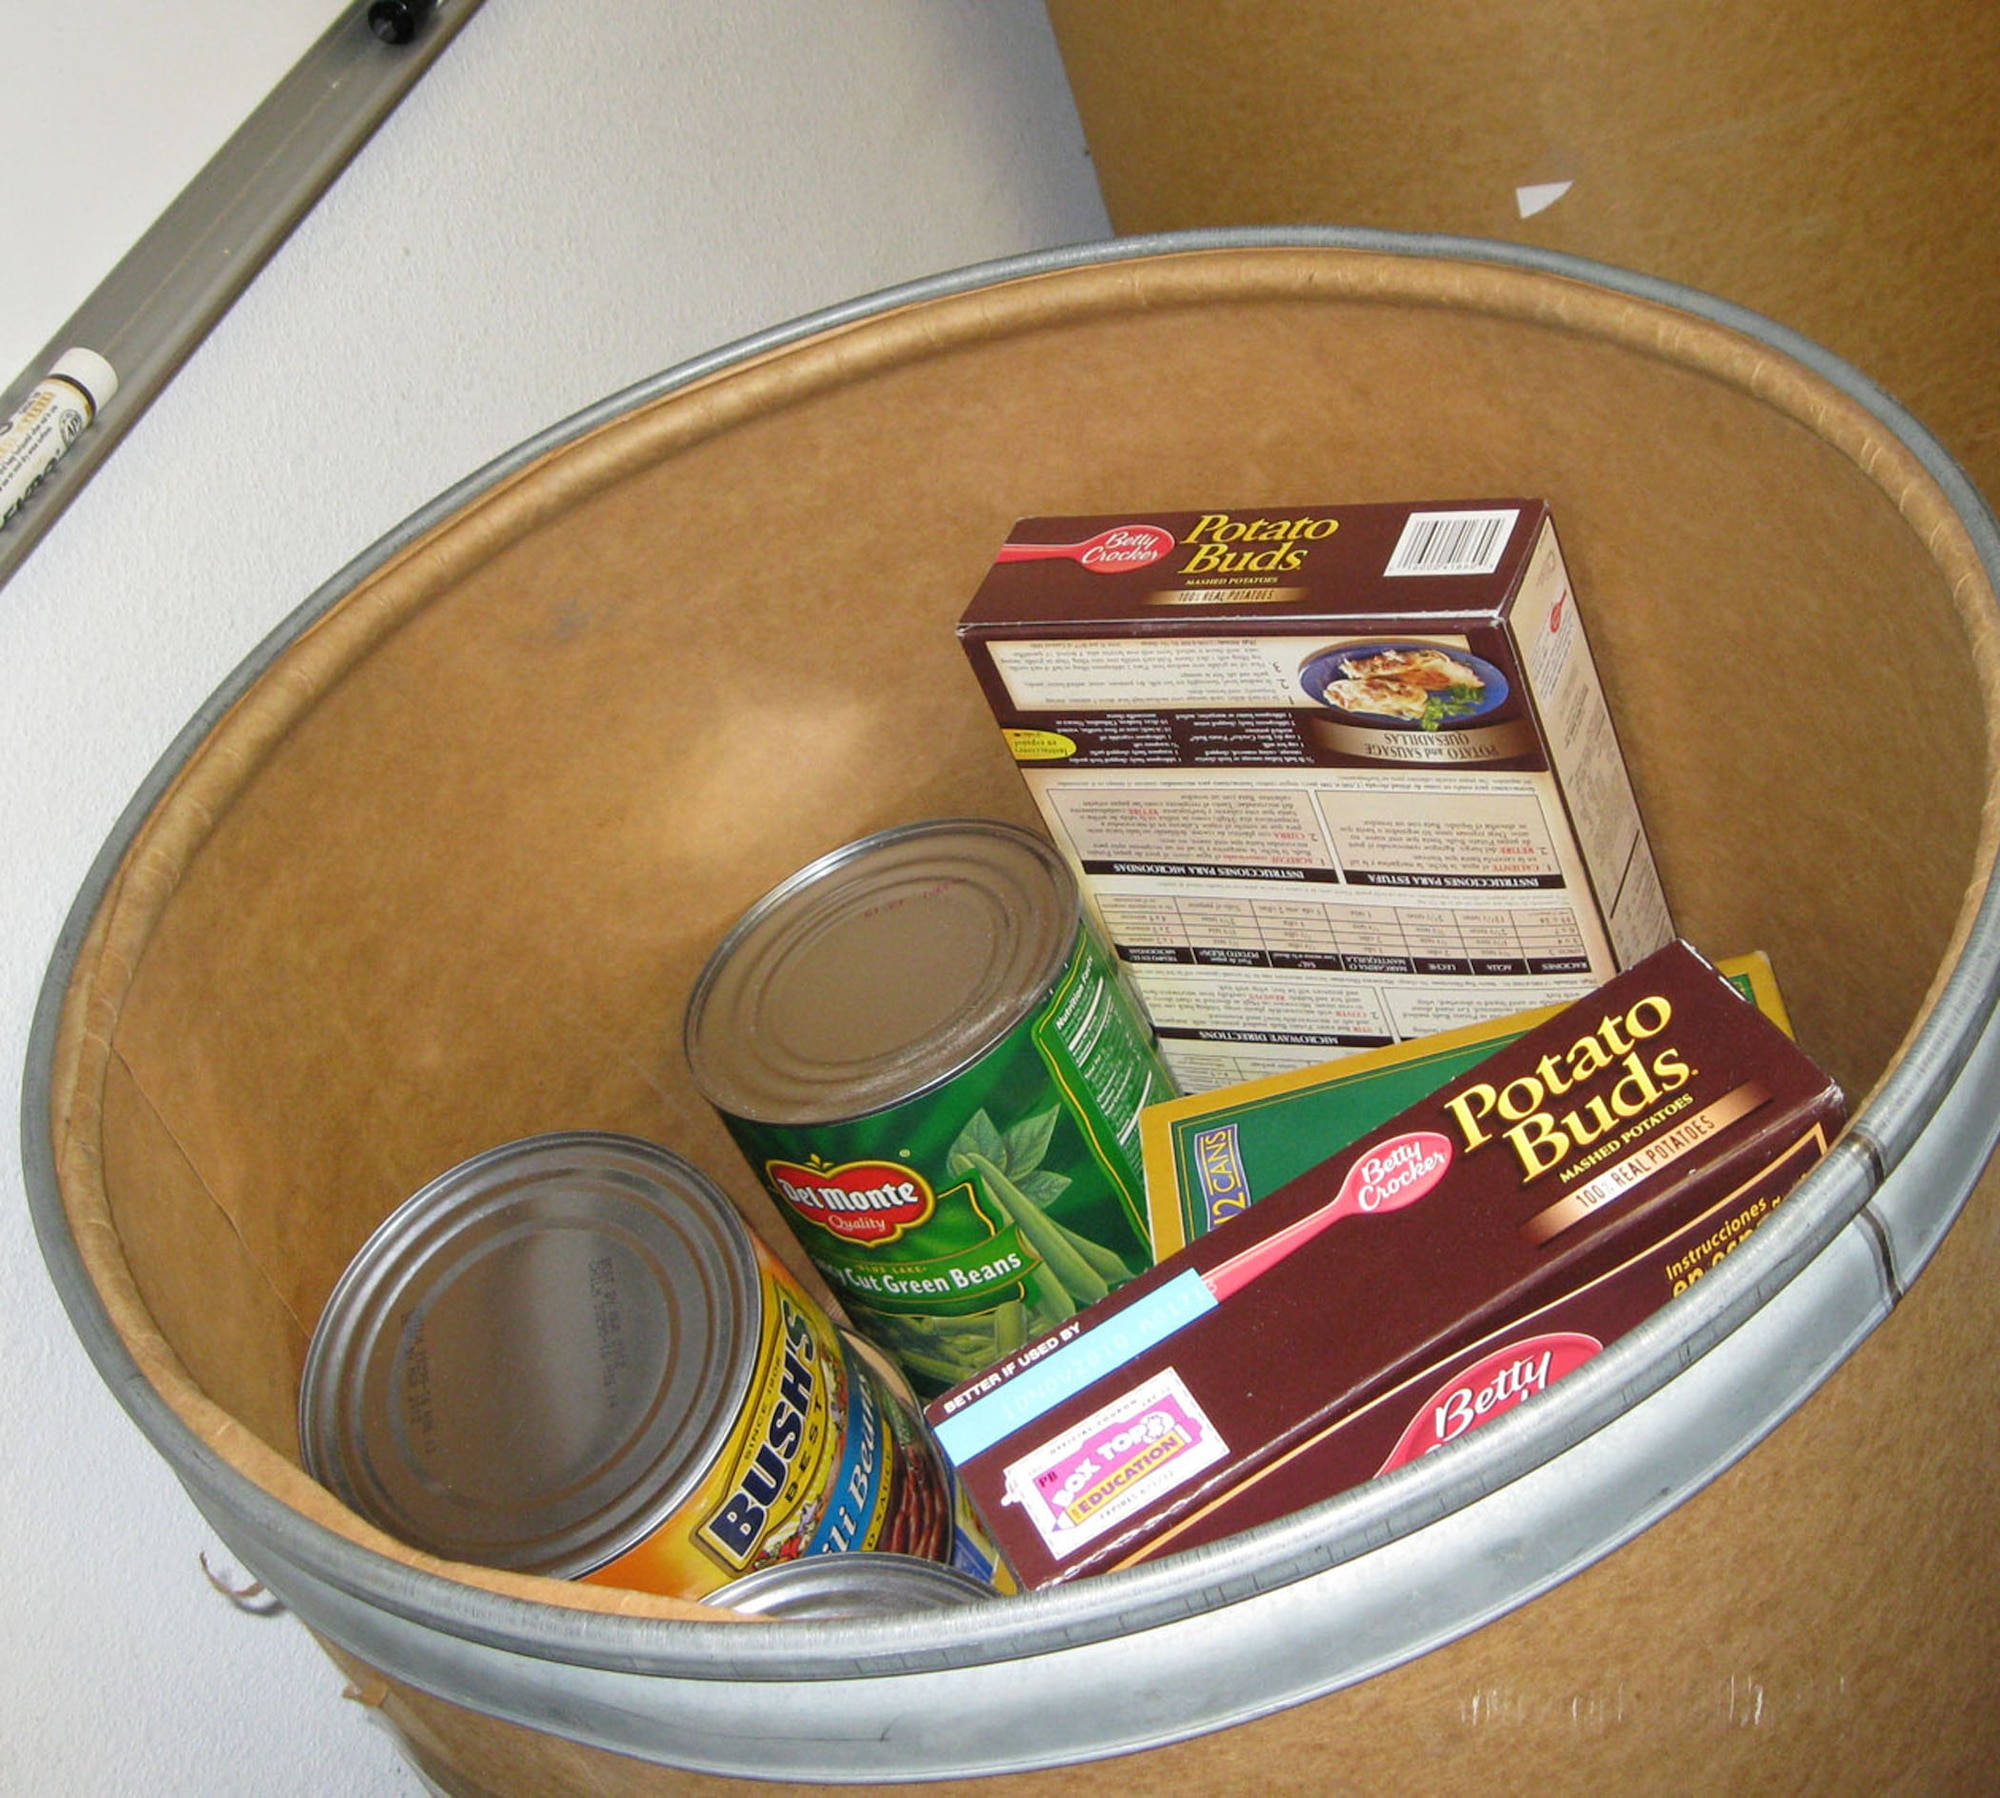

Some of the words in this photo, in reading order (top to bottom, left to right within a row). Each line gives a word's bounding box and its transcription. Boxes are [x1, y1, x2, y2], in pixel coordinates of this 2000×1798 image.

[1105, 532, 1159, 547] Betty
[1180, 515, 1339, 544] Potato
[1082, 546, 1158, 564] Crocker
[1178, 542, 1308, 574] Buds
[1203, 592, 1225, 601] REAL
[1228, 590, 1273, 600] POTATOES
[1362, 742, 1423, 759] SAUSAGE
[1382, 732, 1470, 746] QUESADILLAS
[1422, 747, 1445, 759] and
[1444, 744, 1499, 758] POTATO
[1111, 863, 1187, 873] MICROONDAS
[1185, 865, 1217, 874] PARA
[1215, 866, 1305, 878] INSTRUCCIONES
[1365, 873, 1411, 883] ESTUFA
[1410, 876, 1443, 885] PARA
[1442, 876, 1540, 886] INSTRUCCIONES
[1540, 961, 1589, 970] RACIONES
[1055, 983, 1085, 1030] Nutrition
[1197, 1030, 1268, 1041] DIRECTIONS
[1266, 1033, 1340, 1044] MICROWAVE
[1444, 995, 1672, 1153] Potato
[1559, 1141, 1622, 1184] MASHED
[1622, 1093, 1694, 1146] POTATOES
[1205, 1131, 1235, 1193] CANS
[1362, 1141, 1423, 1184] Betty
[1614, 1153, 1652, 1188] REAL
[1646, 1114, 1716, 1167] POTATOES
[1358, 1152, 1447, 1212] Crocker
[781, 1177, 819, 1210] Del
[818, 1181, 920, 1211] Monte
[828, 1215, 886, 1233] Quality
[1665, 1196, 1768, 1282] Instrucciones
[844, 1268, 882, 1292] Cut
[882, 1274, 950, 1294] Green
[948, 1252, 1022, 1289] Beans
[943, 1371, 1002, 1414] BETTER
[1001, 1360, 1017, 1378] IF
[1017, 1336, 1060, 1368] USED
[1059, 1321, 1082, 1343] BY
[1435, 1350, 1553, 1443] Betty
[698, 1299, 816, 1560] BUSH'S
[784, 1393, 822, 1504] BEST
[1038, 1471, 1059, 1489] PB
[1051, 1456, 1102, 1508] BOX
[1078, 1435, 1178, 1514] EDUCATION
